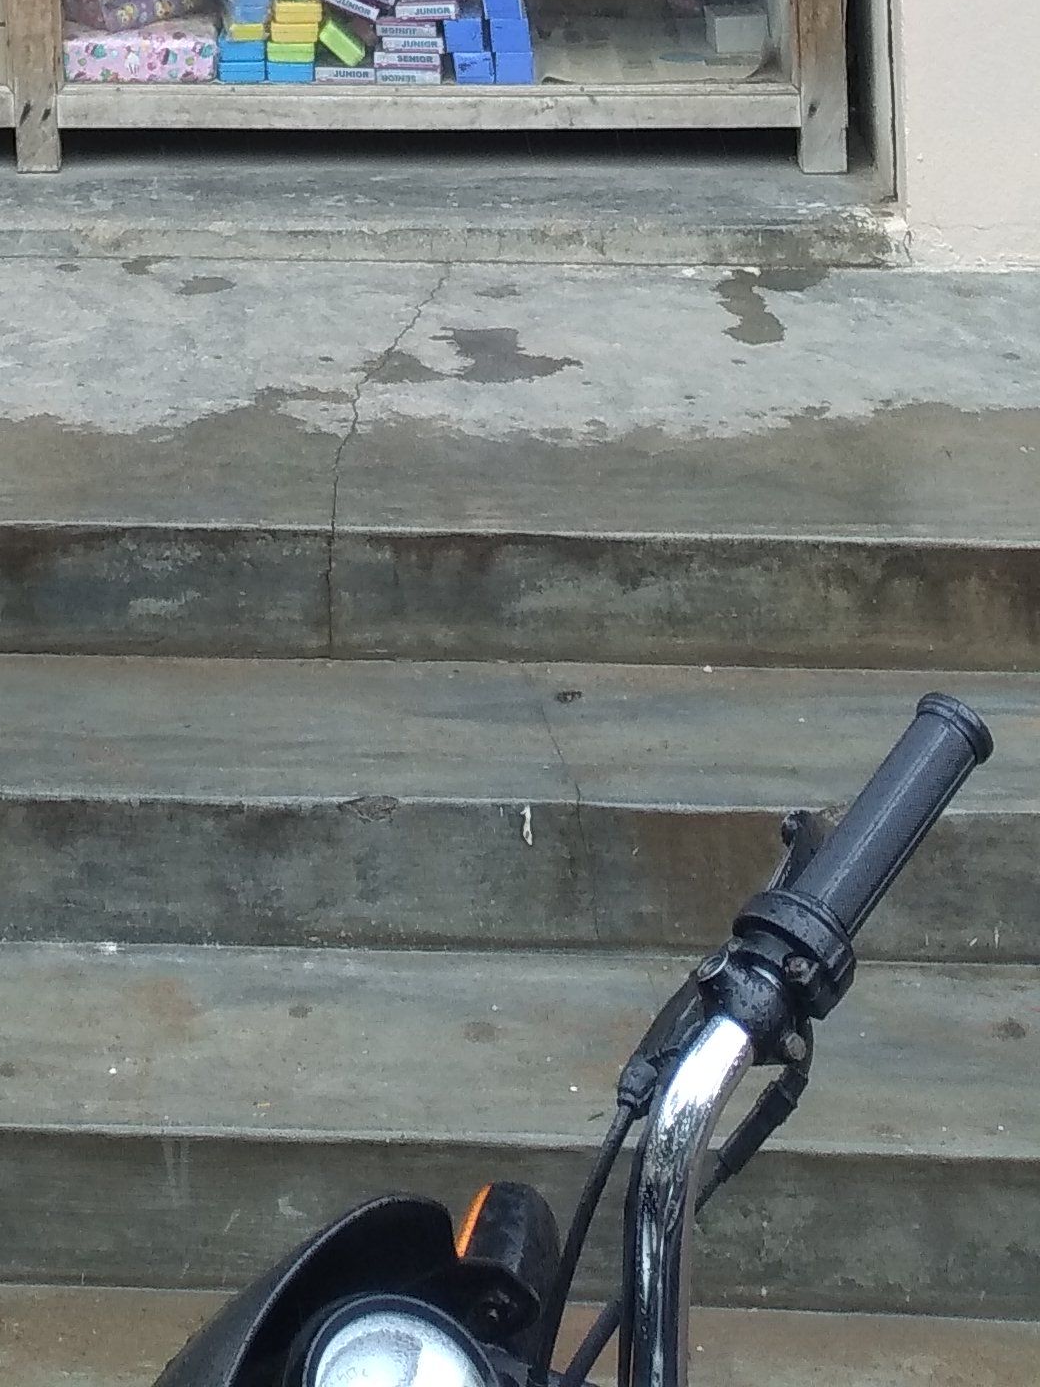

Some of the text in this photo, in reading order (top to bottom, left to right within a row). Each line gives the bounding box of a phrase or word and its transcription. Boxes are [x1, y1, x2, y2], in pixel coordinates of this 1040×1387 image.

[415, 7, 451, 15] JUNIOR
[401, 40, 438, 48] JUNIOR
[397, 55, 433, 63] SENIOR
[334, 69, 369, 78] JUNIOR
